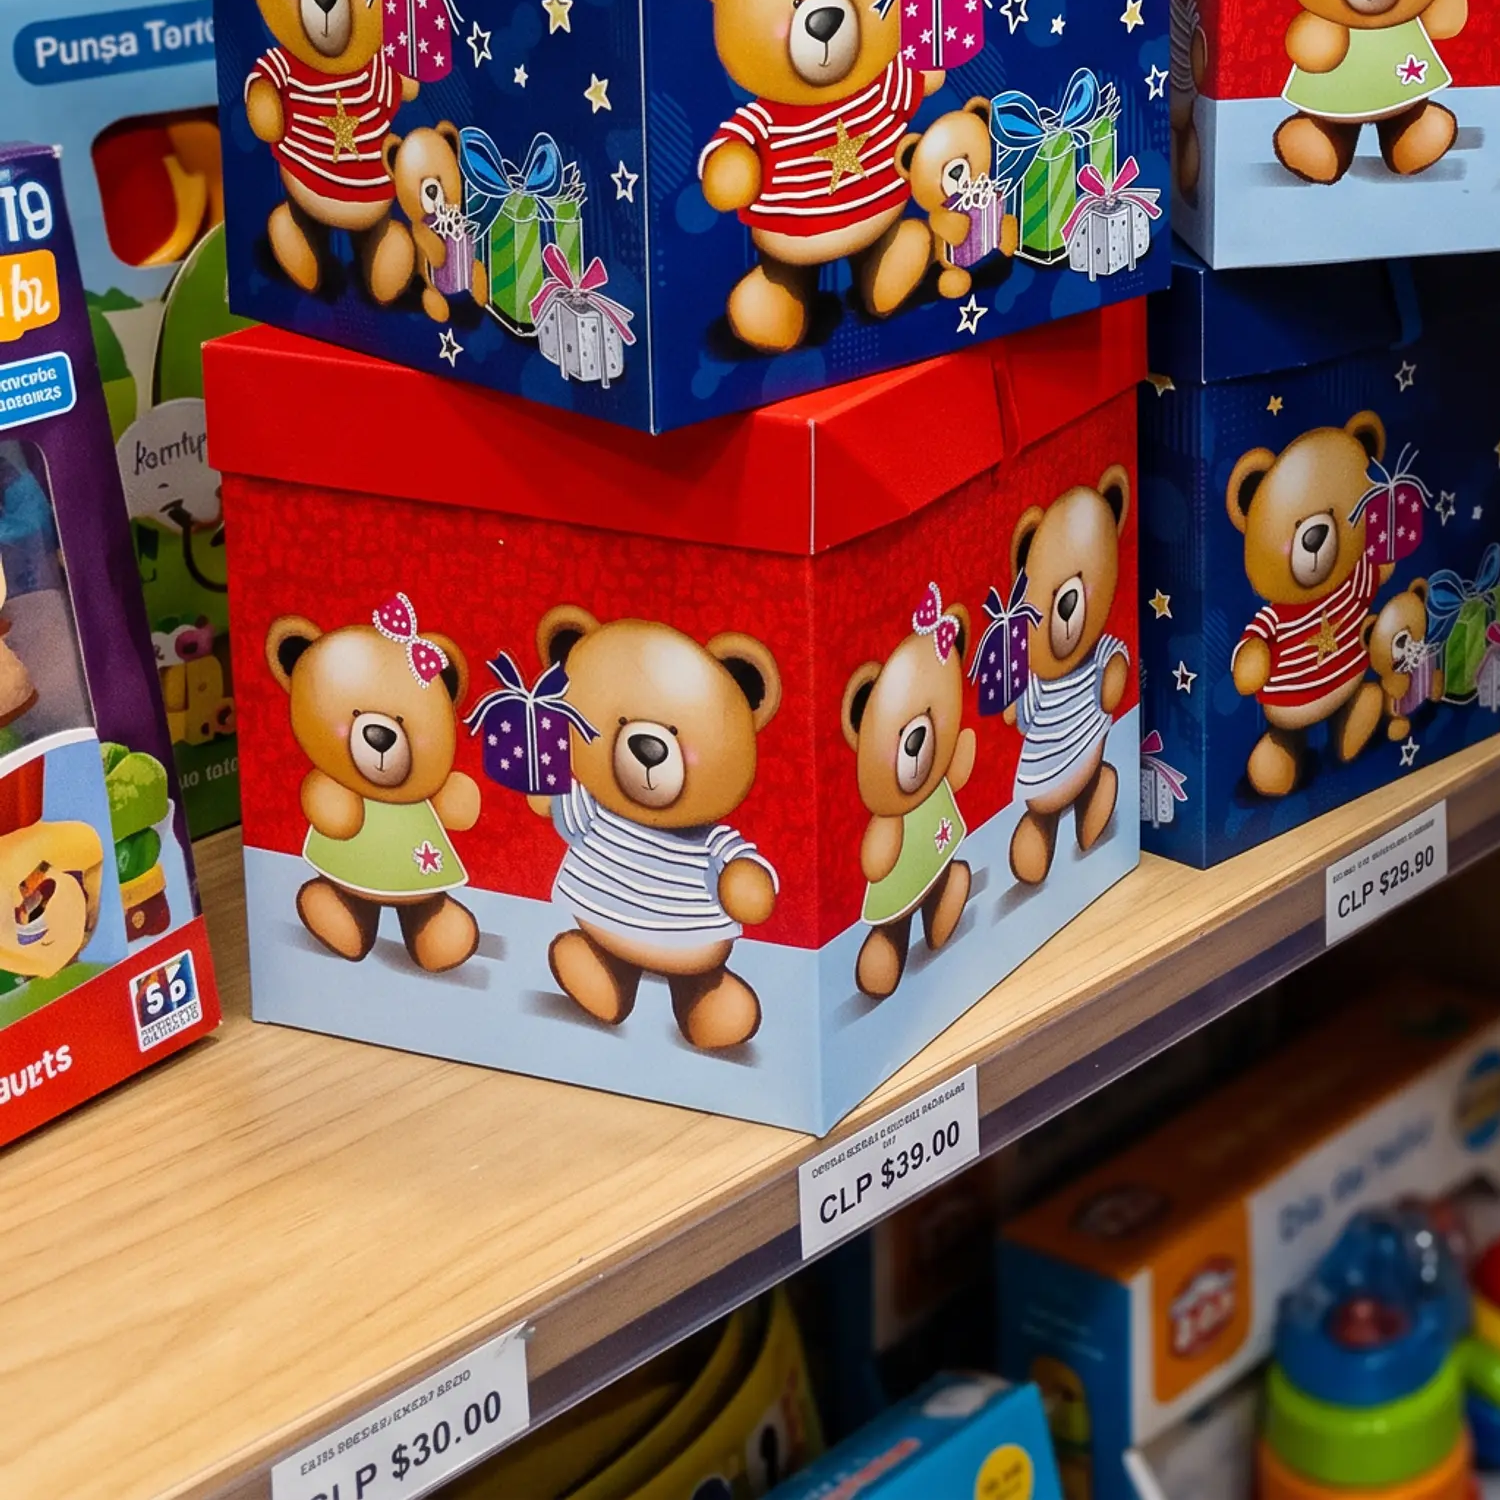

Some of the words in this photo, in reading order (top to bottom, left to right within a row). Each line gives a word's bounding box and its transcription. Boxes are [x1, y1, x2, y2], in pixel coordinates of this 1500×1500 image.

[1338, 880, 1373, 918] CLP
[1379, 845, 1433, 896] $29.90
[820, 1172, 872, 1224] CLP
[881, 1121, 960, 1190] $39.00
[391, 1391, 501, 1482] $30.00
